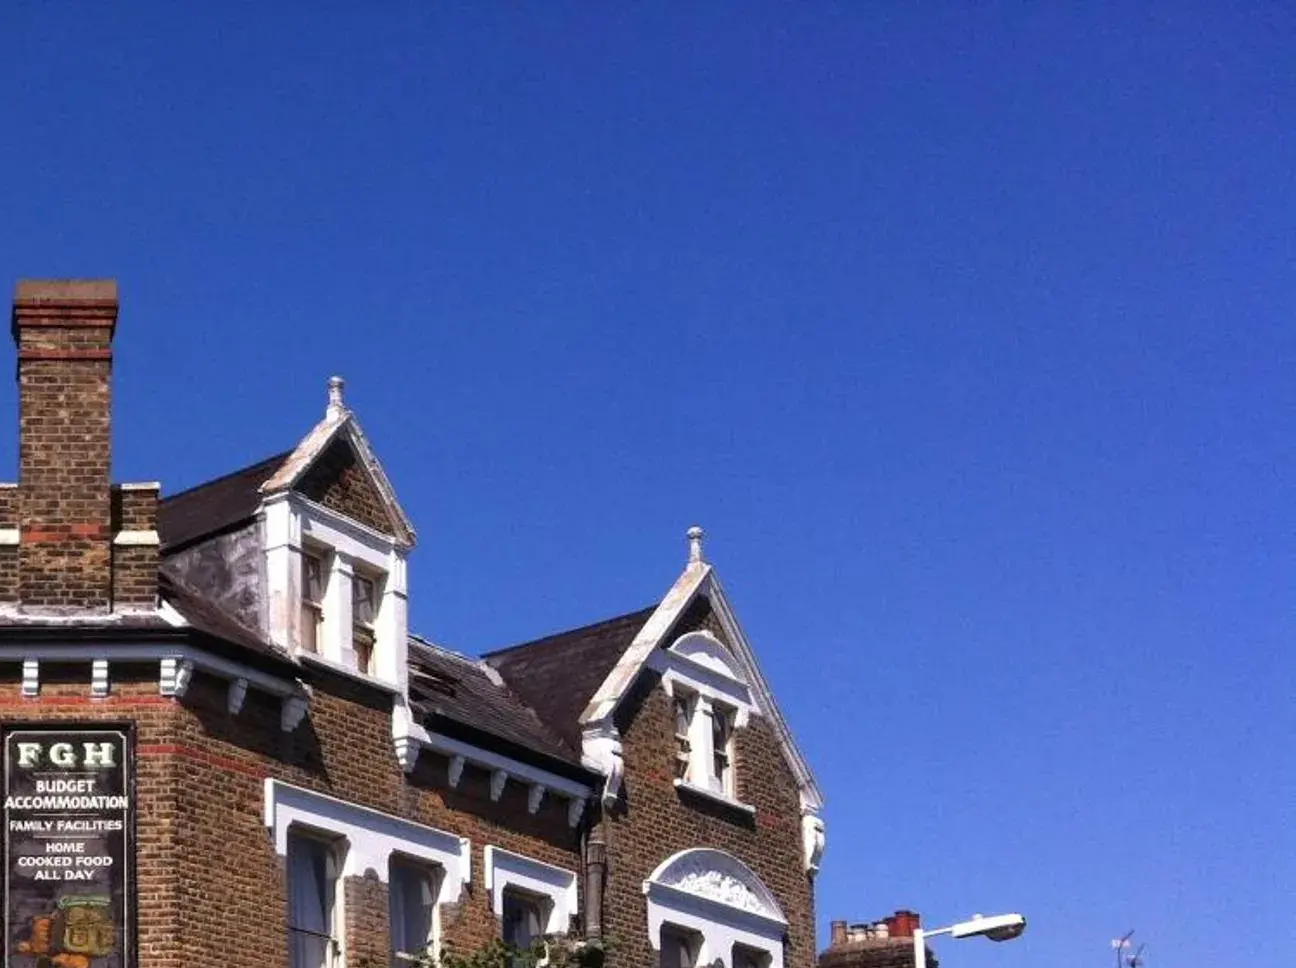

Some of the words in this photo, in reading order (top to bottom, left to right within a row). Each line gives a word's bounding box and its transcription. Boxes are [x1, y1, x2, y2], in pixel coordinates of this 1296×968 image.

[36, 779, 96, 793] BUDGET
[4, 796, 129, 809] ACCOMMODATION
[9, 820, 54, 831] FAMILY
[57, 820, 123, 831] FACILITIES
[45, 842, 85, 853] HOME
[18, 856, 72, 867] COOKED
[75, 856, 113, 867] FOOD
[34, 870, 61, 881] ALL
[64, 870, 95, 881] DAY
